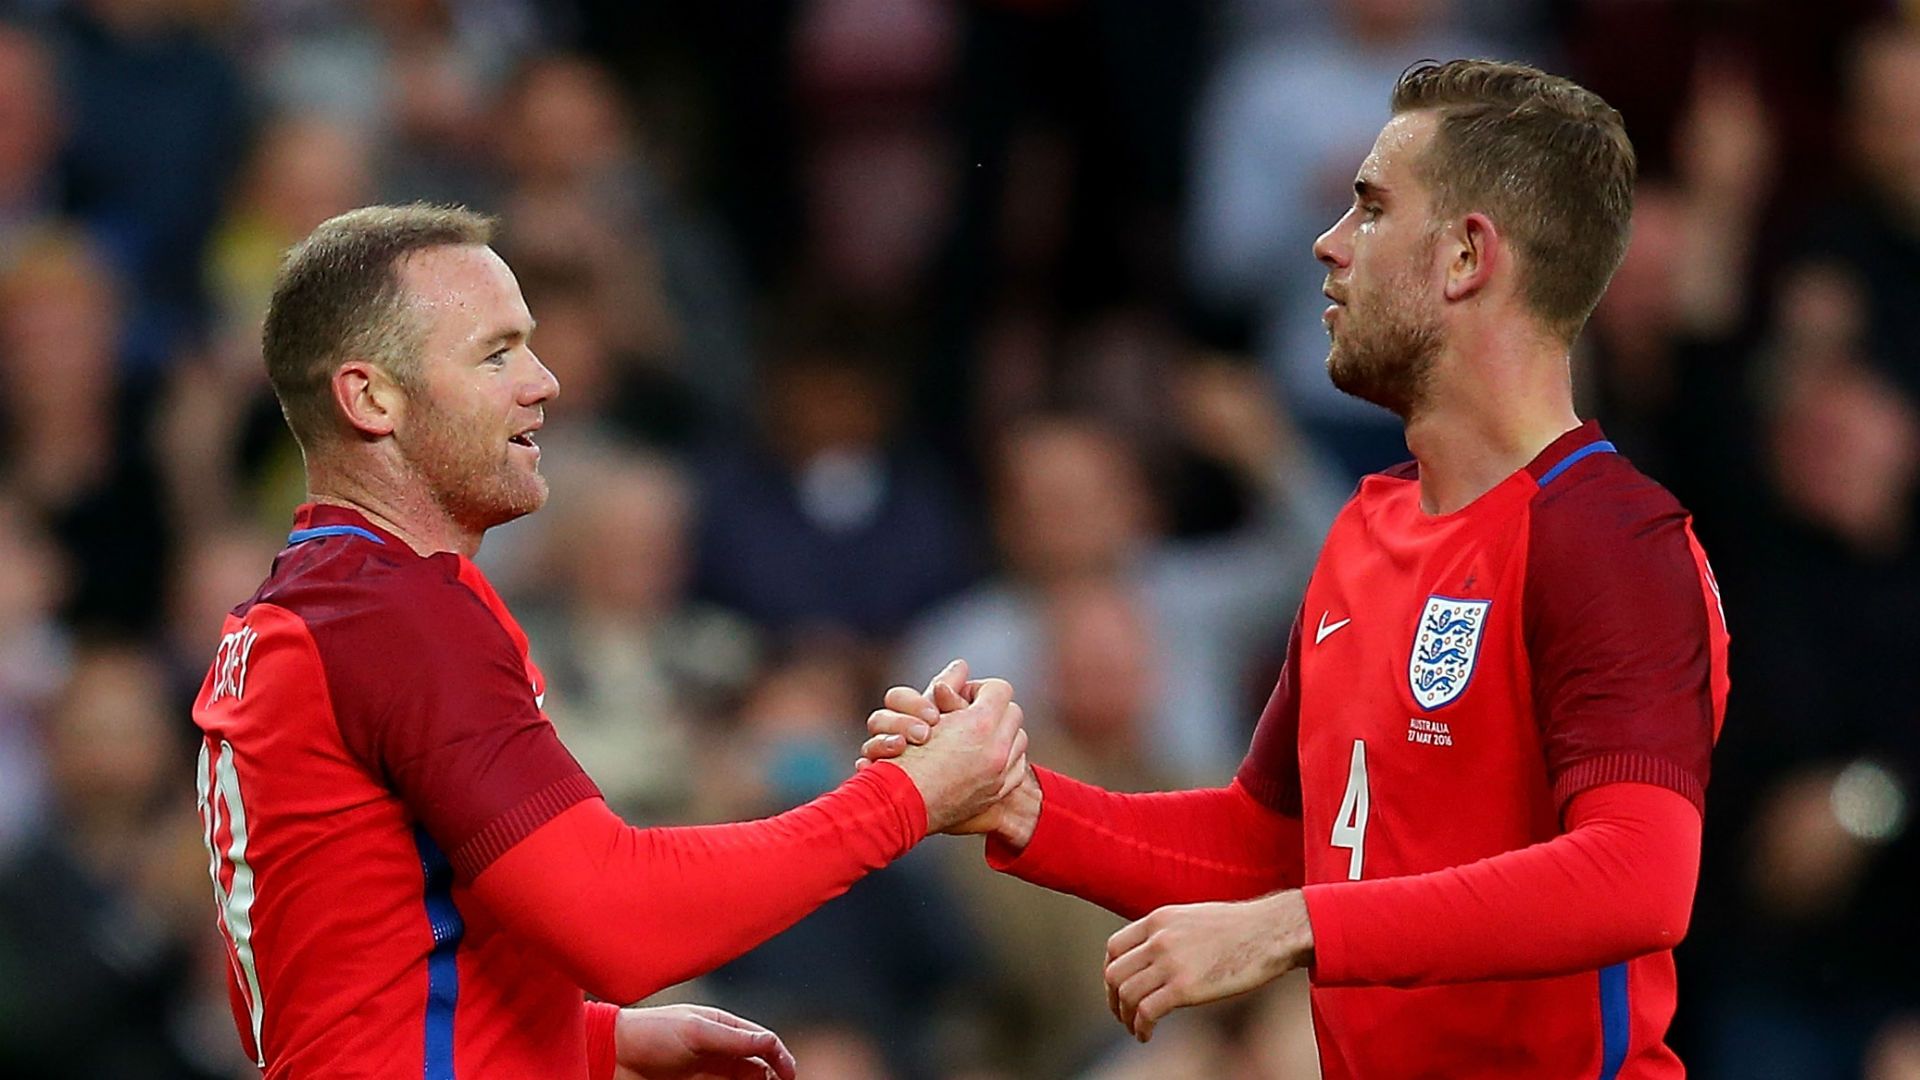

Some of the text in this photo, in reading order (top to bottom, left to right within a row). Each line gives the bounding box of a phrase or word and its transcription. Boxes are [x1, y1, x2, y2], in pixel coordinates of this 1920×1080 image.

[1410, 718, 1450, 734] AUSTRALIA
[1407, 730, 1453, 746] 27 MAY 2016
[1330, 739, 1369, 880] 4
